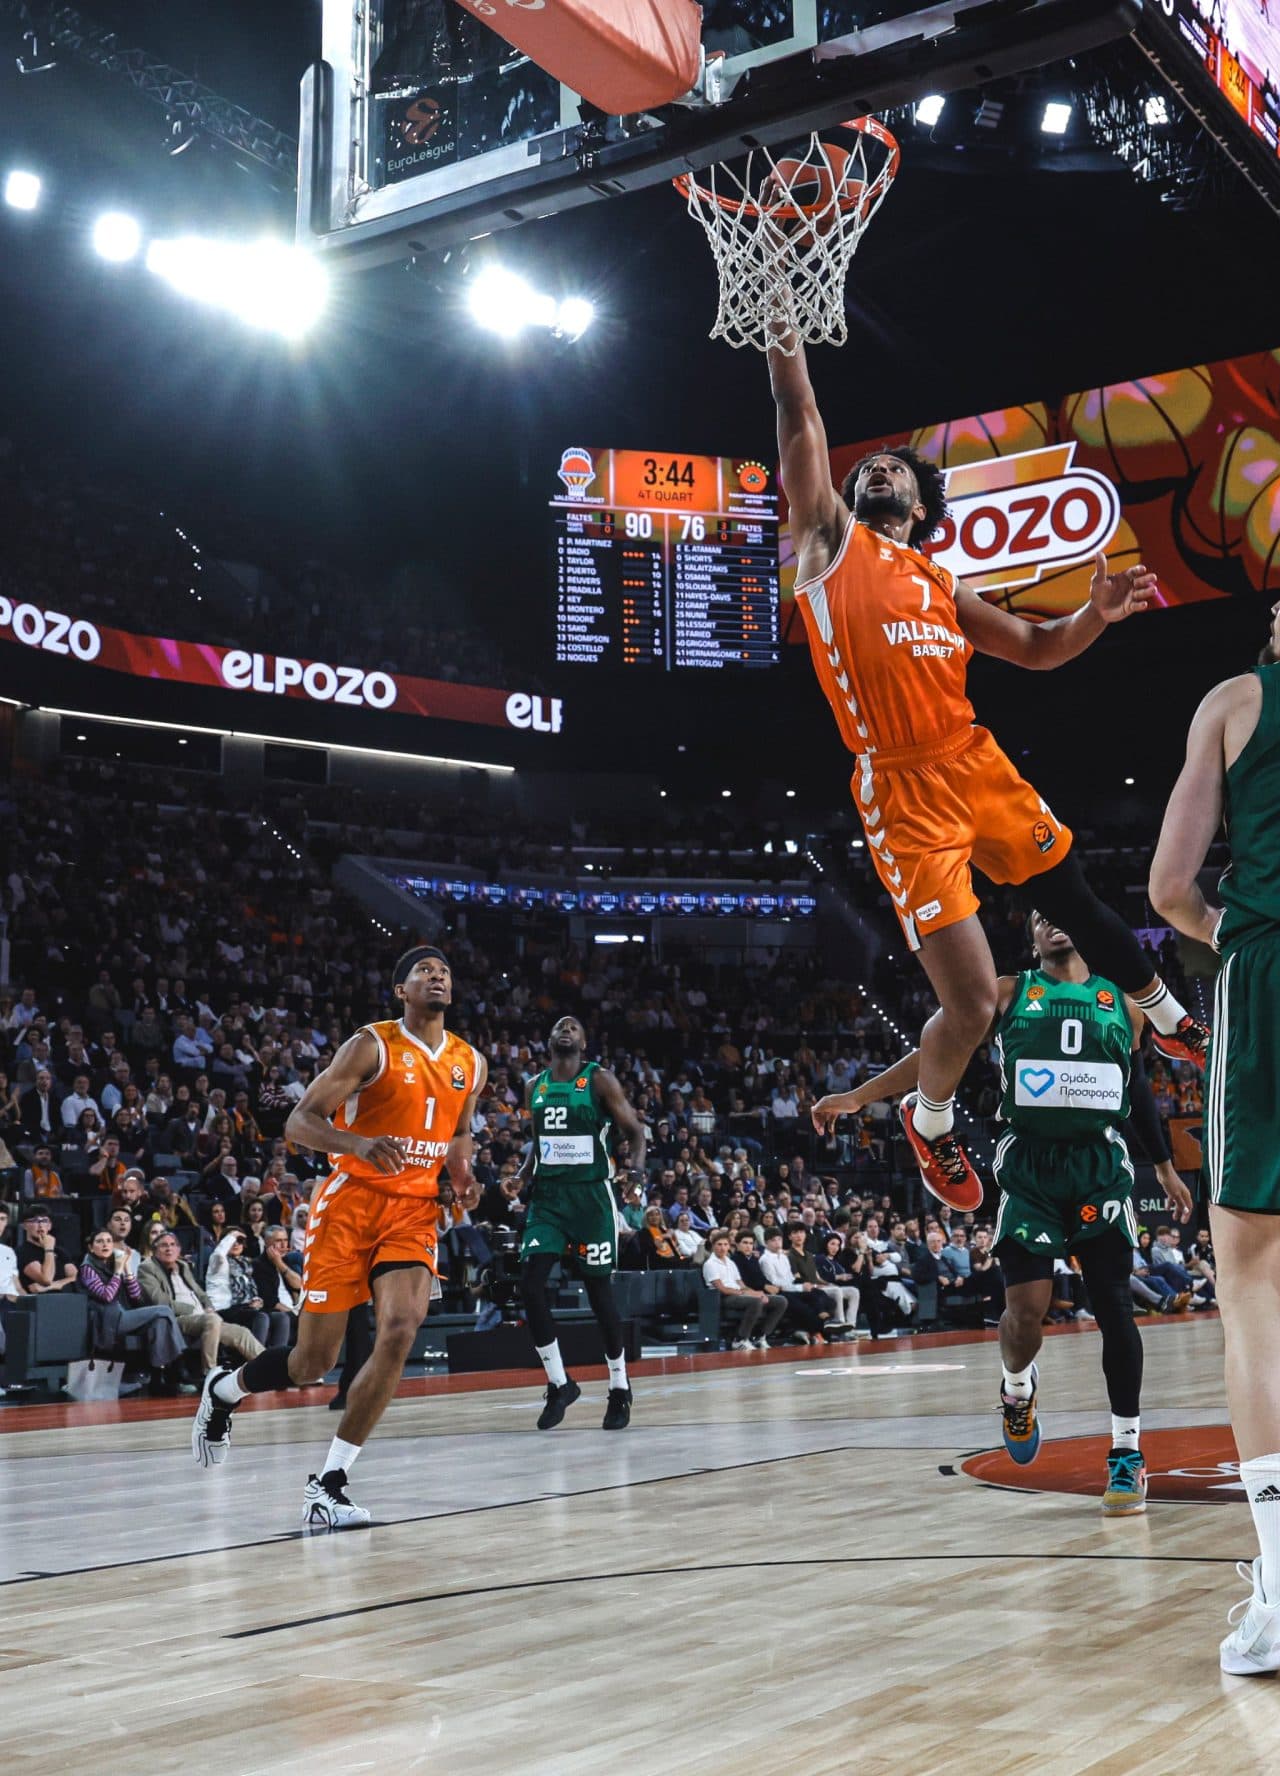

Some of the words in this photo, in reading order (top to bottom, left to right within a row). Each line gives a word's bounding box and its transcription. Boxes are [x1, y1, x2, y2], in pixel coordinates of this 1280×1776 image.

[387, 142, 455, 172] EuroLeague
[644, 459, 695, 488] 3:44
[655, 492, 693, 502] QUART
[625, 512, 652, 538] 90
[678, 515, 705, 541] 76
[574, 538, 613, 548] MARTINEZ
[692, 546, 722, 554] ATAMAN
[567, 557, 595, 565] TAYLOR
[684, 555, 713, 563] SHORTS
[567, 567, 597, 575] PUERTO
[684, 574, 711, 582] OSMAN
[911, 575, 931, 612] 7
[567, 605, 605, 614] MONTERO
[685, 602, 709, 610] GRANT
[567, 634, 610, 643] THOMPSON
[567, 644, 604, 653] COSTELLO
[1060, 1019, 1083, 1055] 0
[1060, 1072, 1097, 1084] Ομάδα
[1060, 1086, 1120, 1100] Προσφοράς
[425, 1097, 436, 1130] 1
[544, 1107, 568, 1130] 22
[586, 1242, 612, 1266] 22
